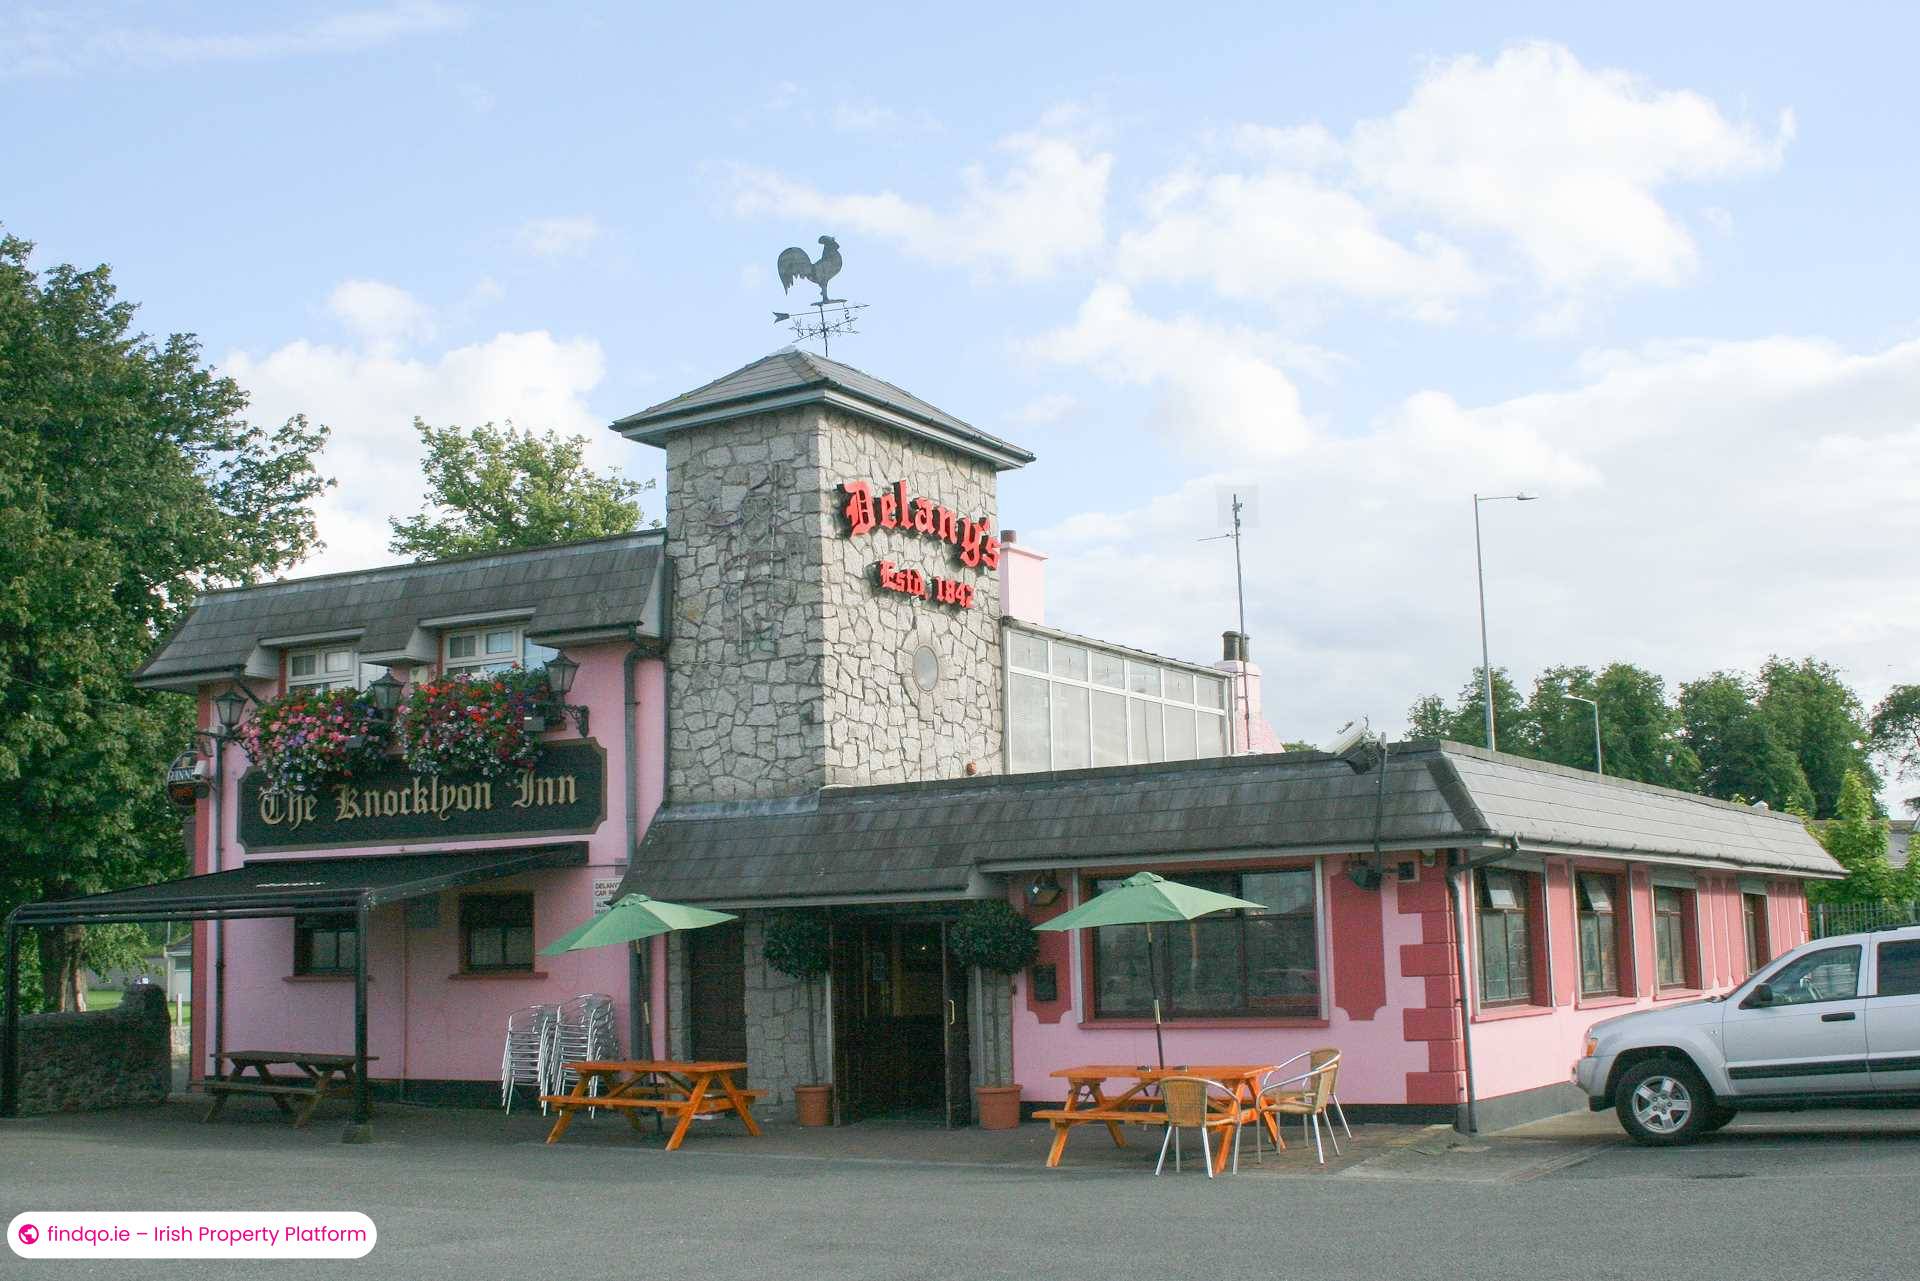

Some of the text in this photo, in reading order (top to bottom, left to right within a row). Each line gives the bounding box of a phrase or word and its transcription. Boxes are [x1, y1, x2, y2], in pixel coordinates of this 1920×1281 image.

[844, 480, 1001, 570] Delany's
[936, 576, 976, 608] 1842
[258, 768, 578, 831] The Knocklyon Inn
